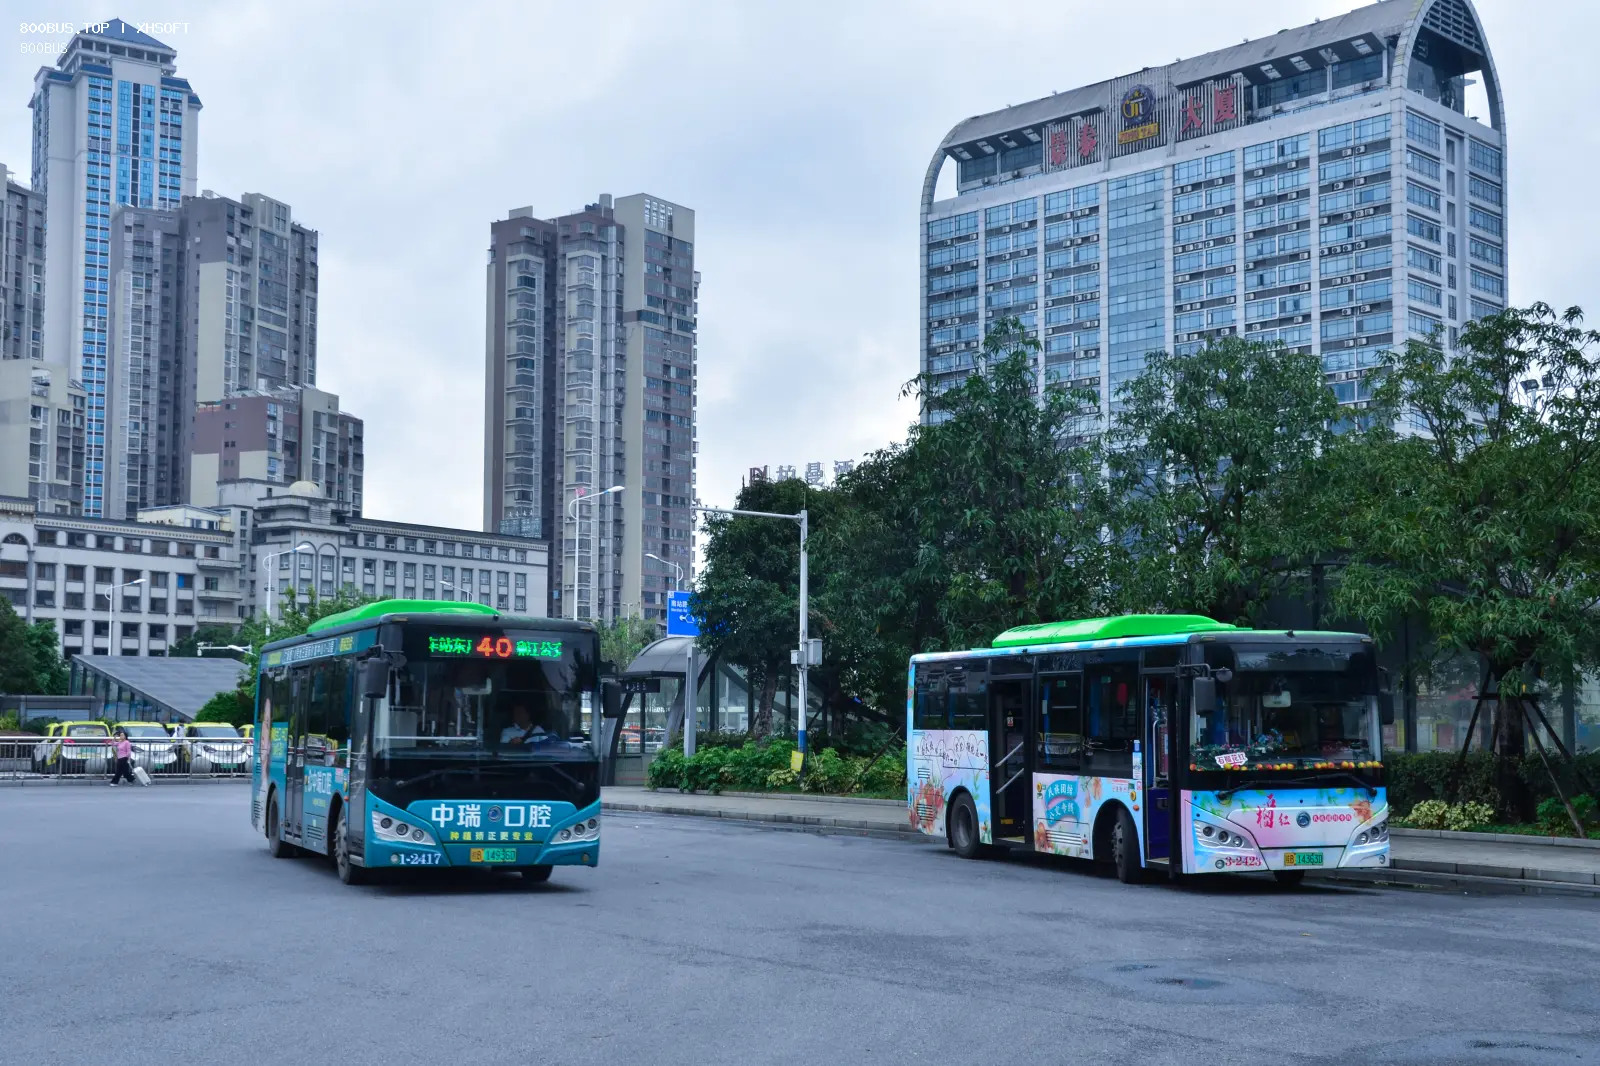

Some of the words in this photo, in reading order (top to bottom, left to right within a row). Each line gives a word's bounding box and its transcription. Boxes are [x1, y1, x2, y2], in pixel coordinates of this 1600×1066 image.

[476, 636, 512, 658] 40
[431, 803, 481, 828] 中瑞
[504, 804, 552, 829] 口腔
[399, 853, 442, 866] 1-2417
[1225, 855, 1262, 868] 3-2423
